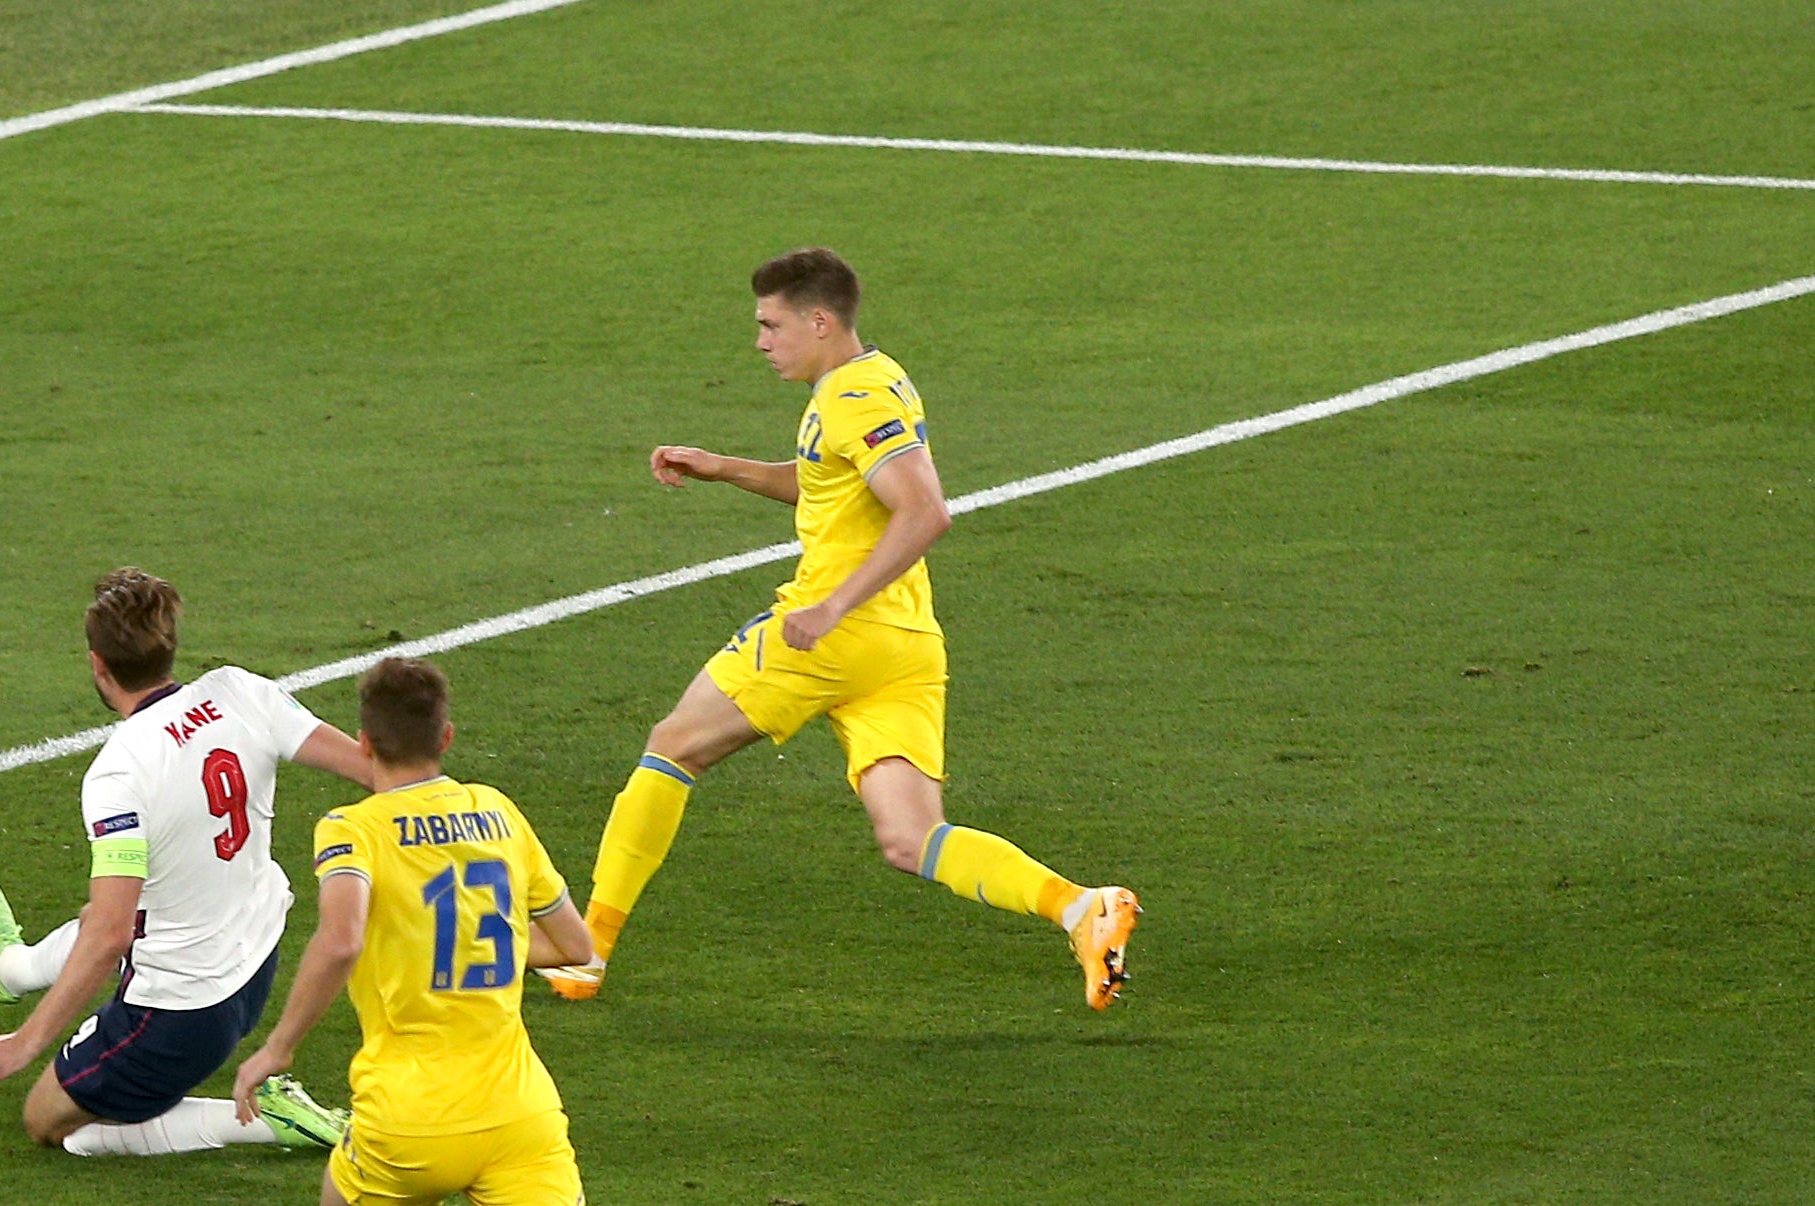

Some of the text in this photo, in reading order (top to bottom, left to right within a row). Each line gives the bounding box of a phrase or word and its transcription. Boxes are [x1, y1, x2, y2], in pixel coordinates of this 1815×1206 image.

[164, 699, 224, 748] KANE
[202, 747, 251, 863] 9
[392, 810, 512, 846] ZABARNYI
[422, 858, 517, 990] 13
[69, 1014, 99, 1049] 9
